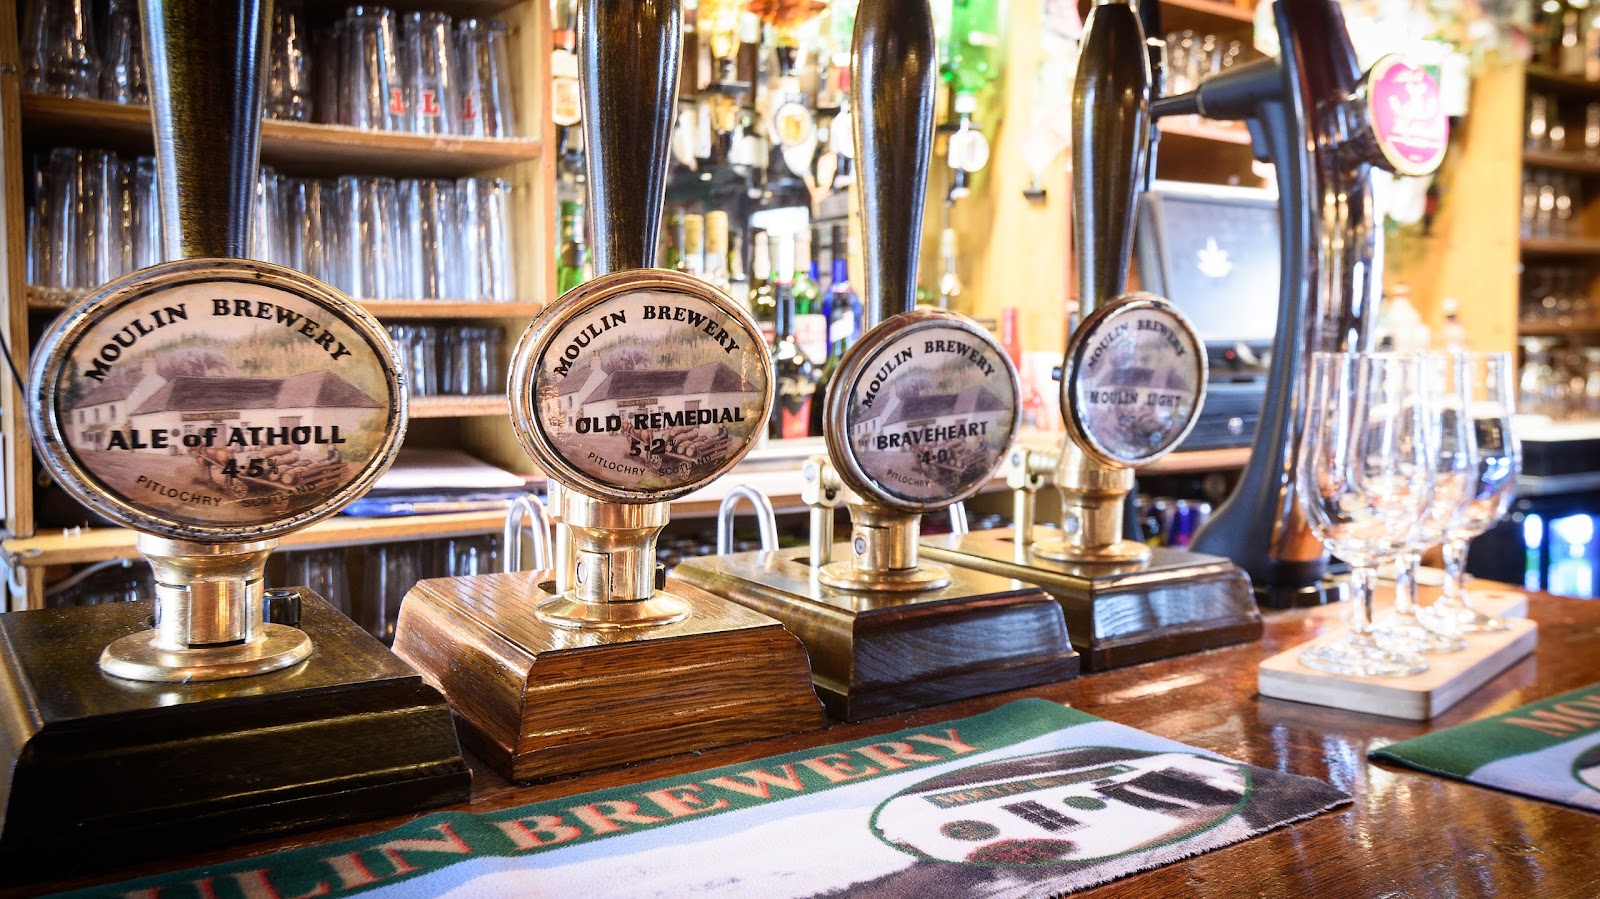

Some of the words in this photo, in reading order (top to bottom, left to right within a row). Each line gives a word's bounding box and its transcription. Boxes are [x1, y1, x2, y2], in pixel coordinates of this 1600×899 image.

[85, 303, 189, 383] MOULIN
[211, 299, 351, 361] BREWERY
[554, 309, 627, 378] MOULIN
[643, 305, 740, 354] BREWERY
[1088, 322, 1128, 367] MOULIN
[1137, 319, 1185, 356] BREWERY
[862, 347, 914, 409] MOULIN
[924, 340, 995, 377] BREWERY
[1090, 390, 1138, 405] MOULIN
[575, 415, 622, 434] OLD
[634, 407, 745, 430] REMEDIAL
[876, 421, 988, 450] BRAVEHEART
[106, 428, 169, 451] ALE
[182, 428, 218, 448] of
[227, 425, 346, 448] ATHOLL
[587, 451, 646, 476] PITLOCHRY
[659, 454, 712, 477] SCOTLAND
[136, 475, 222, 507] PITLOCHRY
[498, 727, 982, 852] BREWERY
